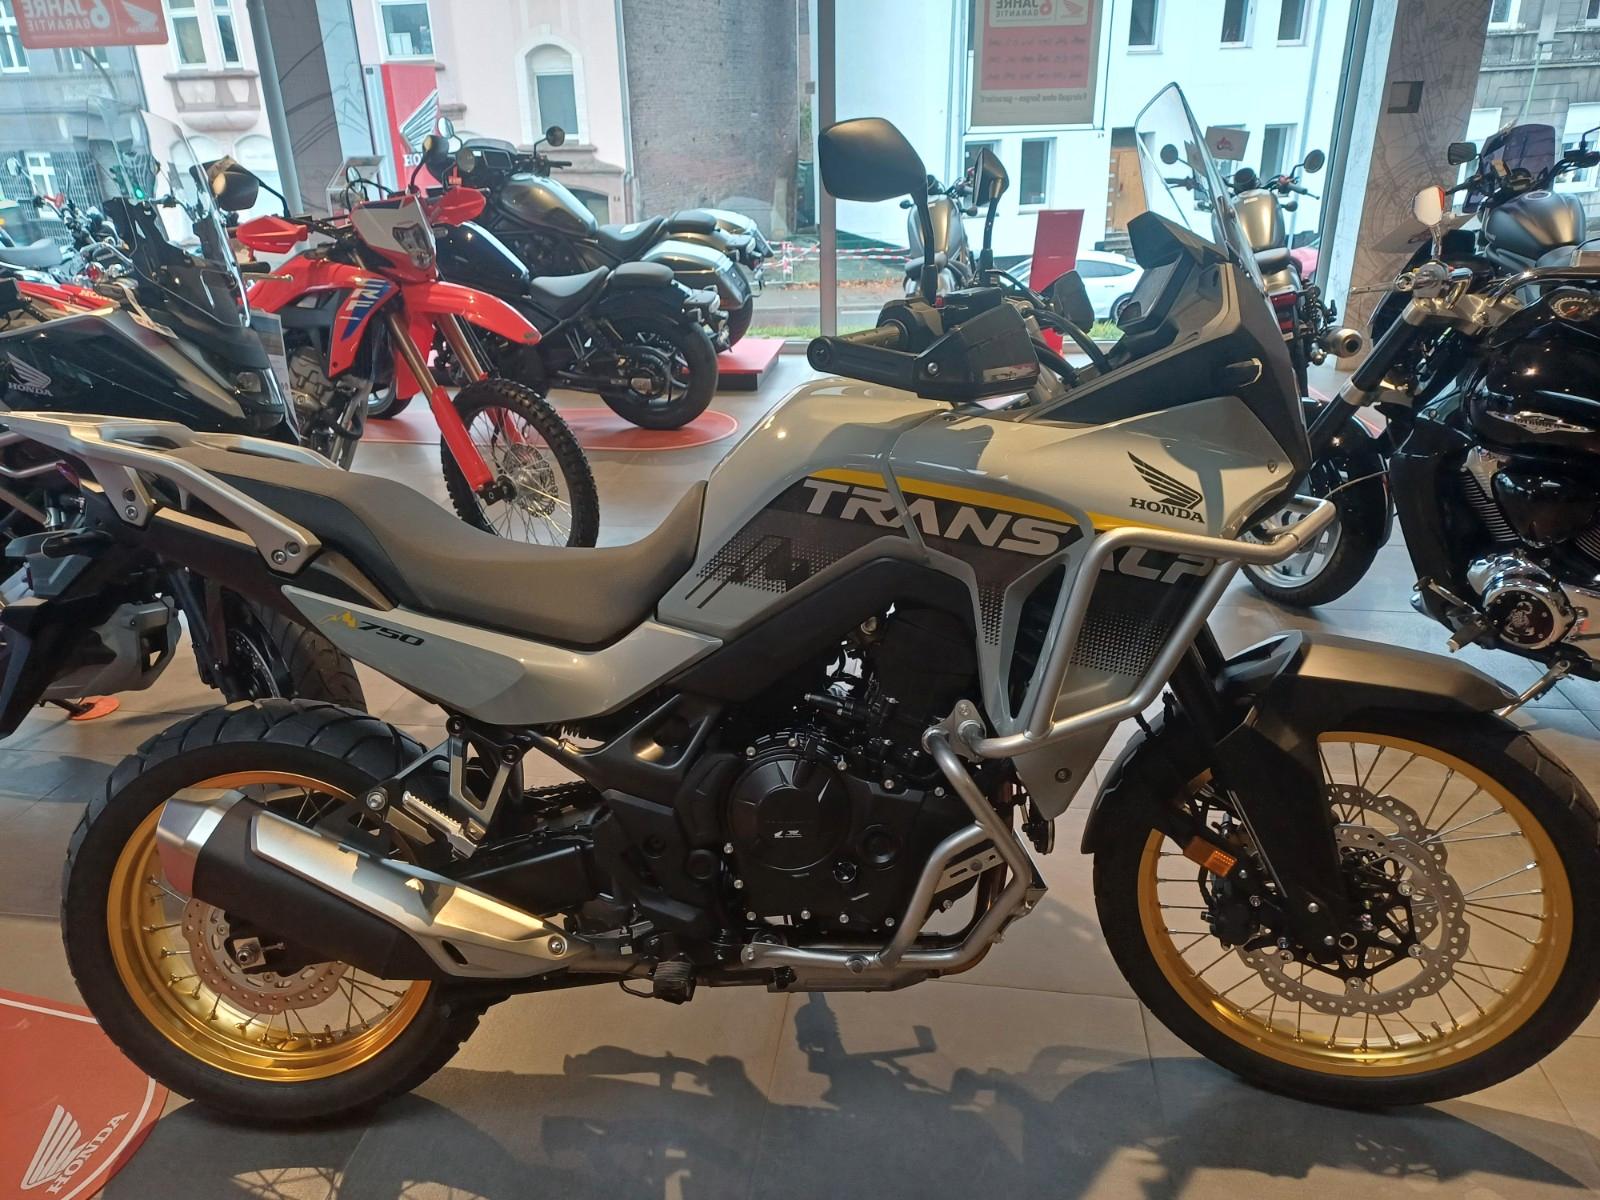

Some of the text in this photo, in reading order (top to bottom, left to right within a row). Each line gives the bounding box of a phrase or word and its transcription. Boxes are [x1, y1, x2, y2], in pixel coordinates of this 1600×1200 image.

[8, 381, 54, 397] HONDA
[1129, 497, 1205, 524] HONDA
[358, 621, 425, 646] 750
[45, 1111, 131, 1195] HONDA
